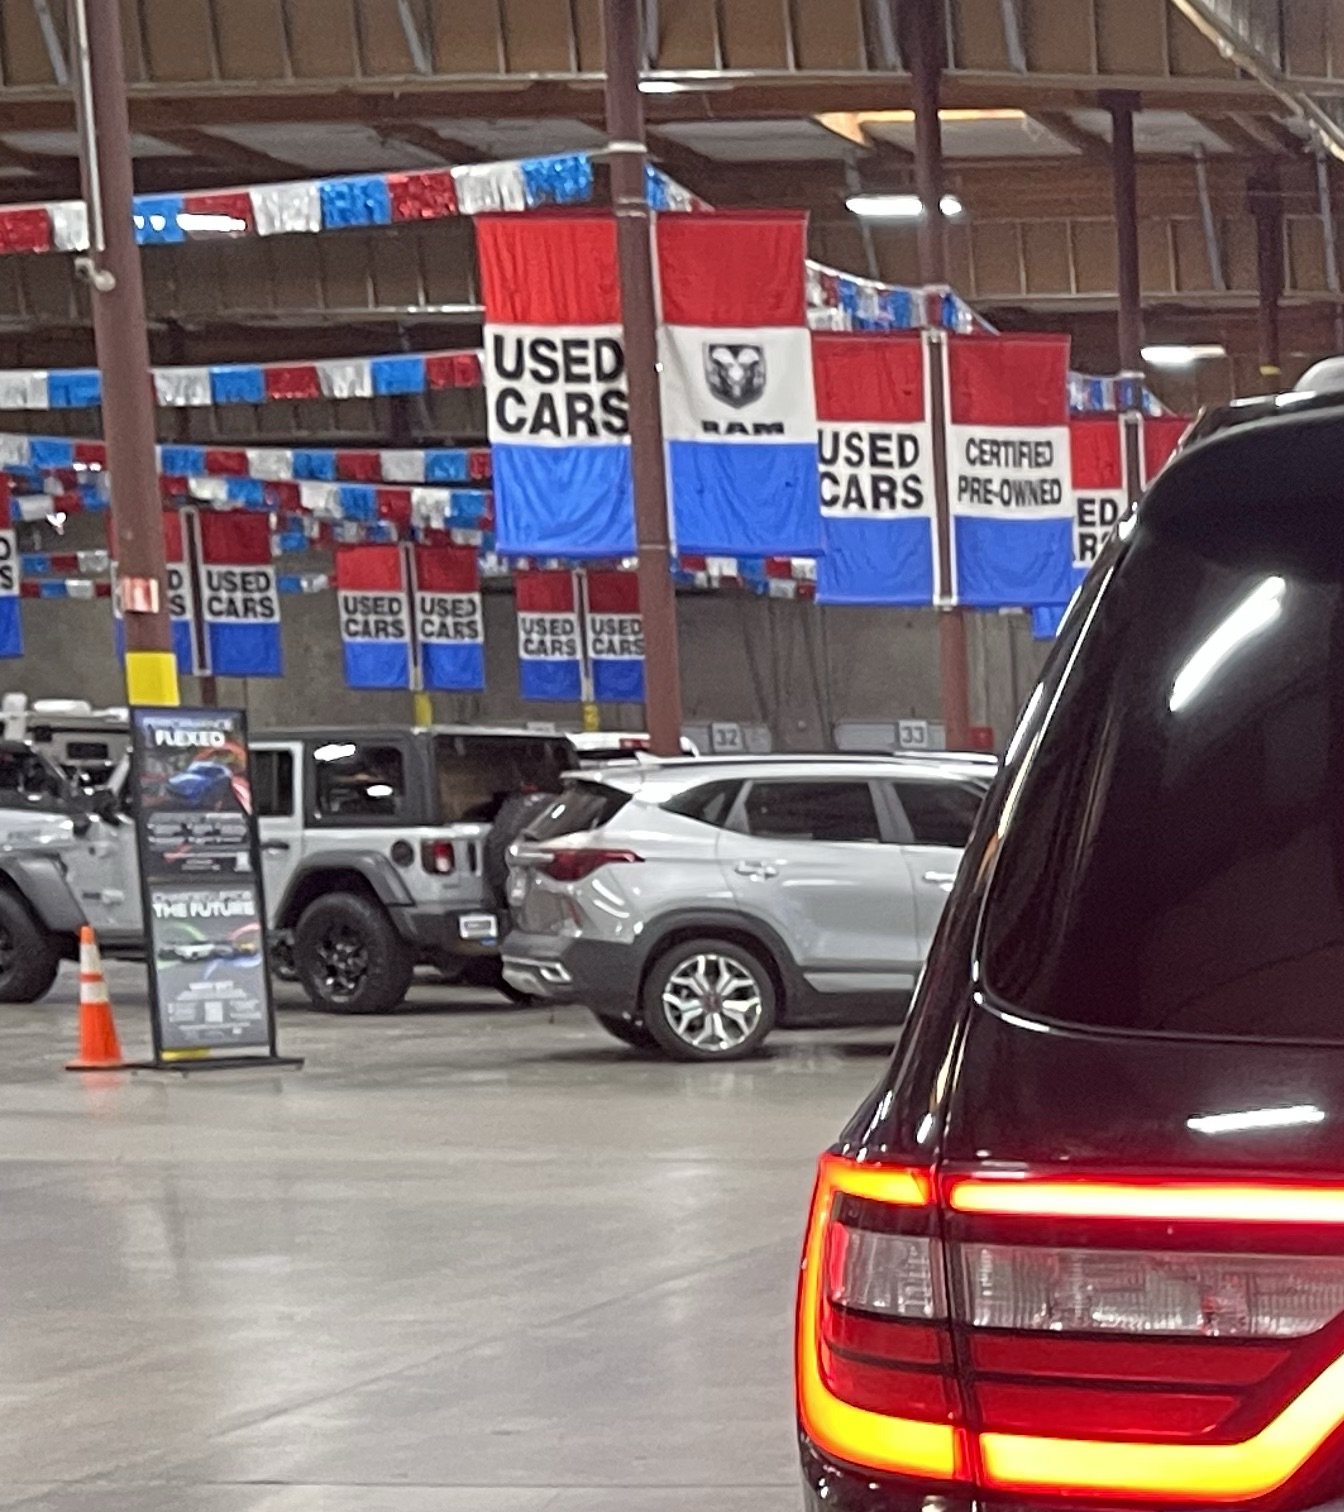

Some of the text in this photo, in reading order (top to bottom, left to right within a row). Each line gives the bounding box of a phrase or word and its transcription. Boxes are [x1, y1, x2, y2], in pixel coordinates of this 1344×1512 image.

[493, 335, 624, 384] USED
[495, 387, 629, 437] CARS
[702, 420, 784, 435] RAM
[818, 430, 920, 469] USED
[965, 437, 1054, 468] CERTIFIED
[820, 473, 923, 510] CARS
[958, 474, 1062, 507] PRE-OWNED
[207, 570, 271, 593] USED
[207, 596, 275, 618] CARS
[343, 596, 401, 616] USED
[420, 597, 477, 617] USED
[344, 618, 405, 638] CARS
[421, 618, 479, 639] CARS
[521, 618, 575, 636] USED
[591, 618, 642, 636] USED
[522, 639, 577, 657] CARS
[591, 639, 644, 657] CARS
[715, 729, 738, 746] 32
[901, 726, 925, 743] 33
[152, 902, 187, 918] THE
